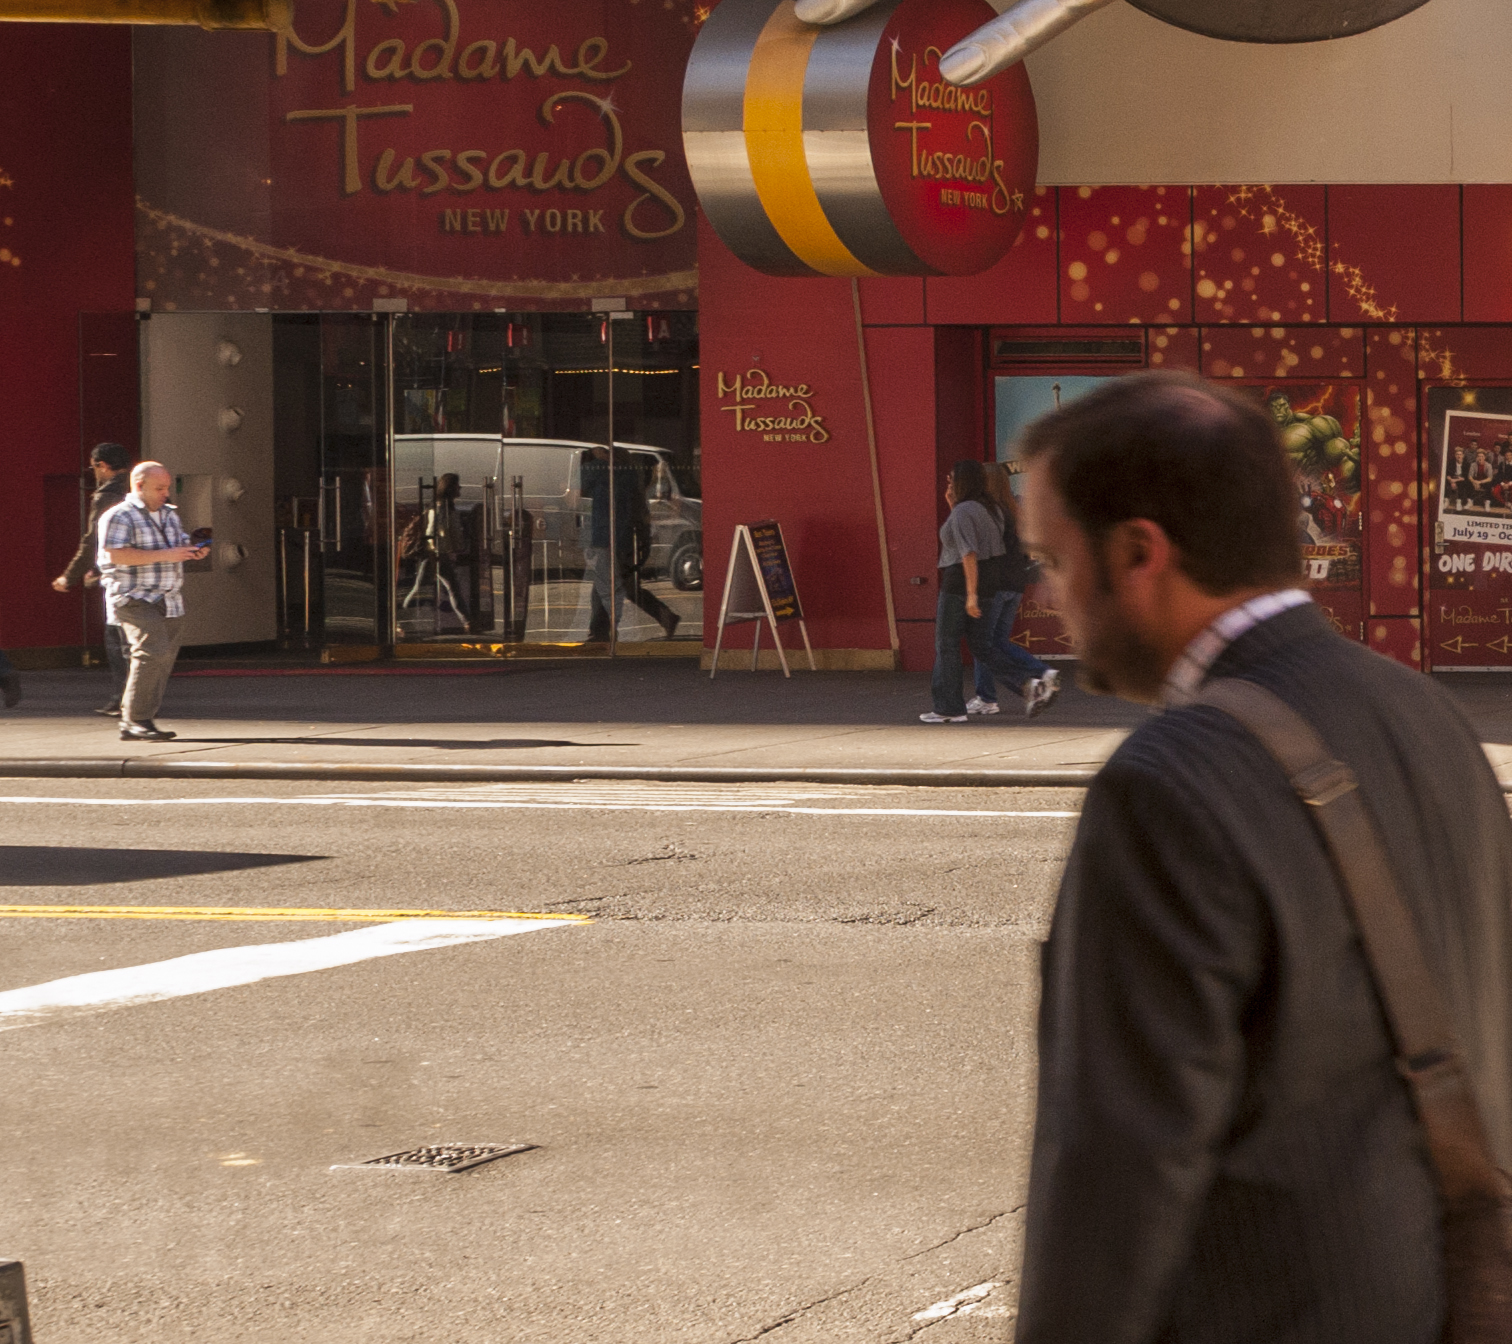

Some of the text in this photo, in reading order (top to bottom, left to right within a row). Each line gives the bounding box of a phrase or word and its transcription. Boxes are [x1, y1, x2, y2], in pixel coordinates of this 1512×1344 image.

[890, 44, 992, 117] Madame
[286, 89, 686, 240] Tussauds
[894, 120, 1010, 215] Tussauds
[941, 188, 989, 209] NEW YORK
[443, 207, 607, 234] NEW YORK
[717, 368, 815, 403] Madame
[720, 399, 830, 444] Tussauds
[1438, 551, 1476, 573] ONE
